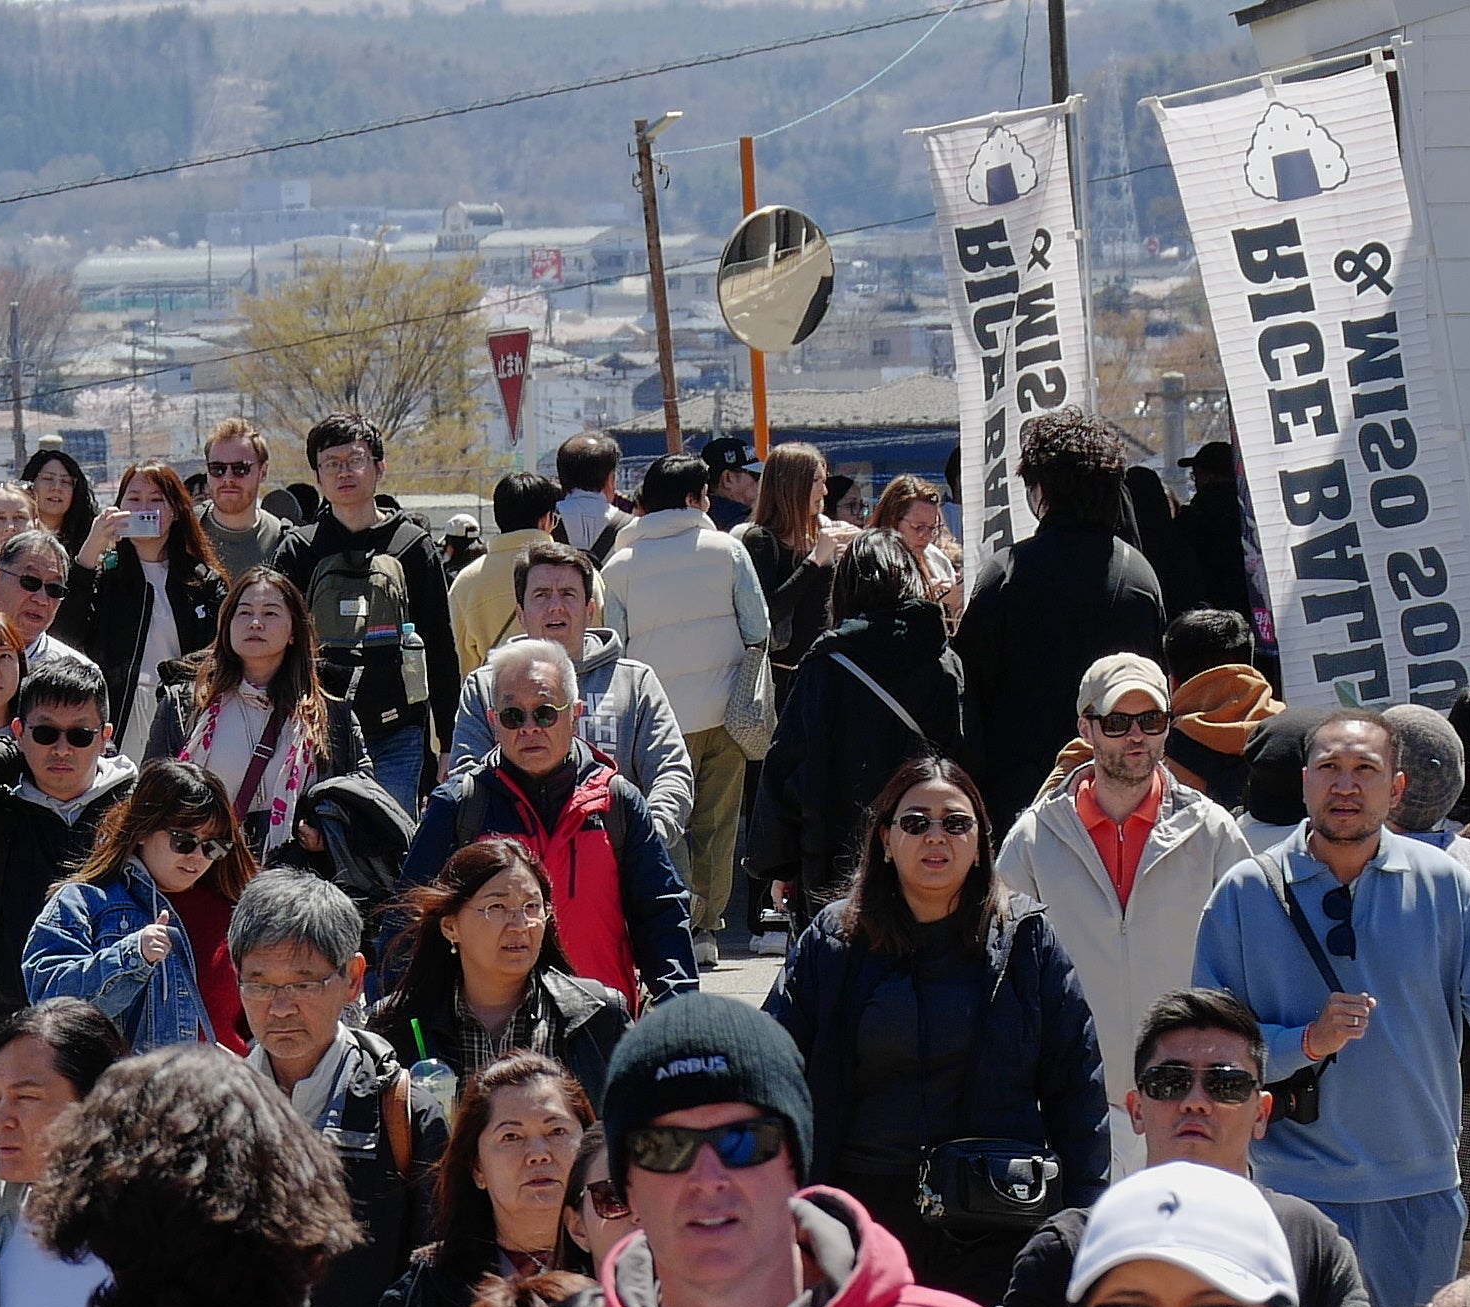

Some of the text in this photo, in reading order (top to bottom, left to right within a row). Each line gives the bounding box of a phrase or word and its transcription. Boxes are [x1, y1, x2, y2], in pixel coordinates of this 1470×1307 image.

[498, 351, 523, 379] 止まれ
[654, 1055, 728, 1081] AIRBUS
